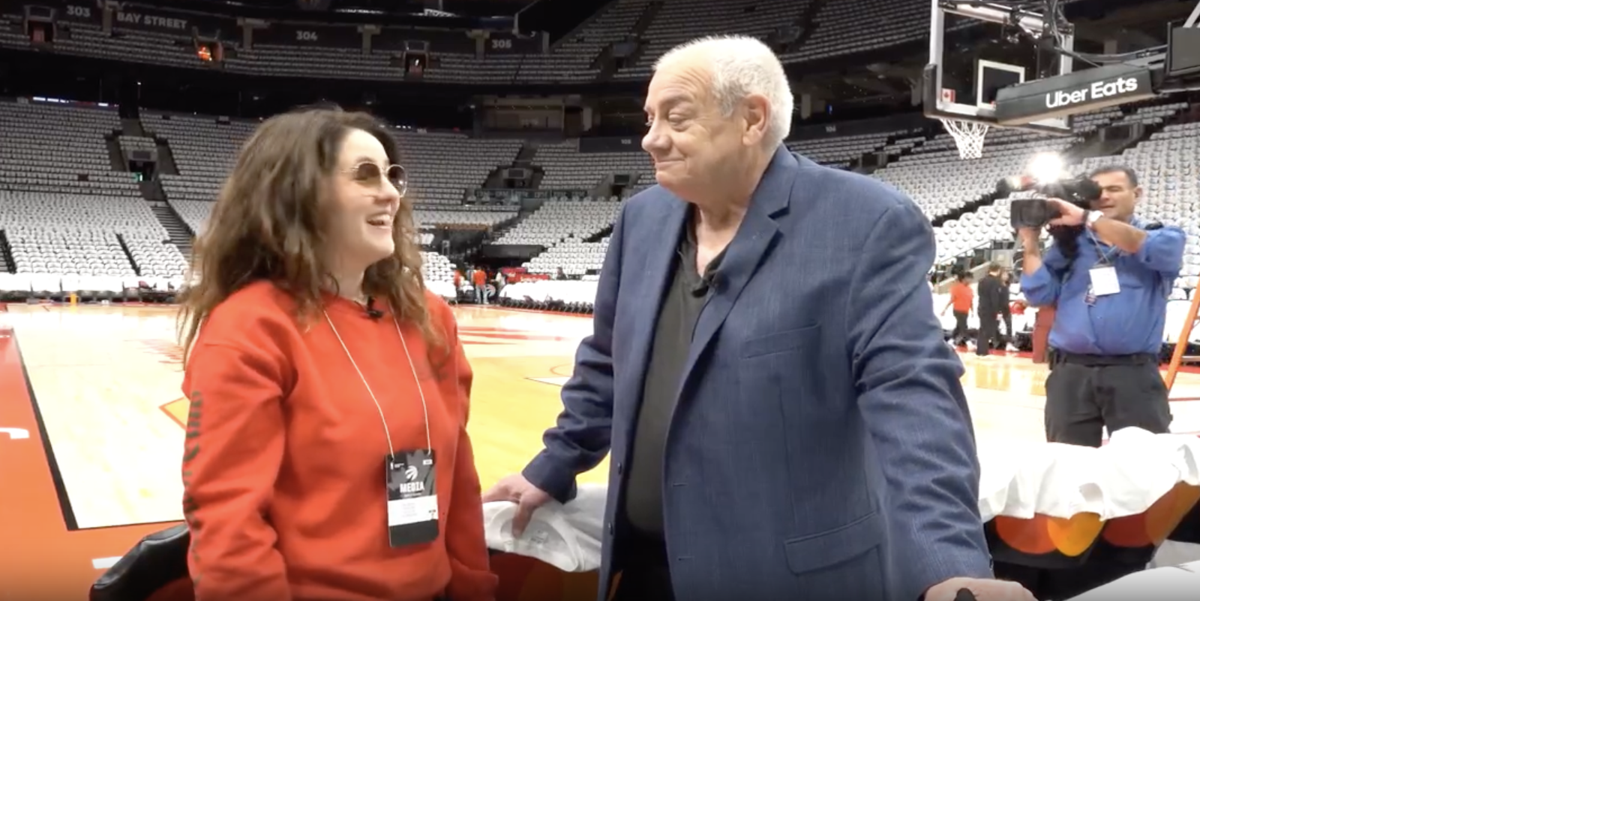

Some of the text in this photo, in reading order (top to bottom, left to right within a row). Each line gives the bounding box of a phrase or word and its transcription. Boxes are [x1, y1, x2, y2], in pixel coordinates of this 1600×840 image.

[66, 5, 91, 17] 303
[117, 12, 188, 29] BAY STREET
[296, 30, 318, 41] 304
[1045, 77, 1138, 108] Uber Eats
[400, 481, 425, 493] MEDIA
